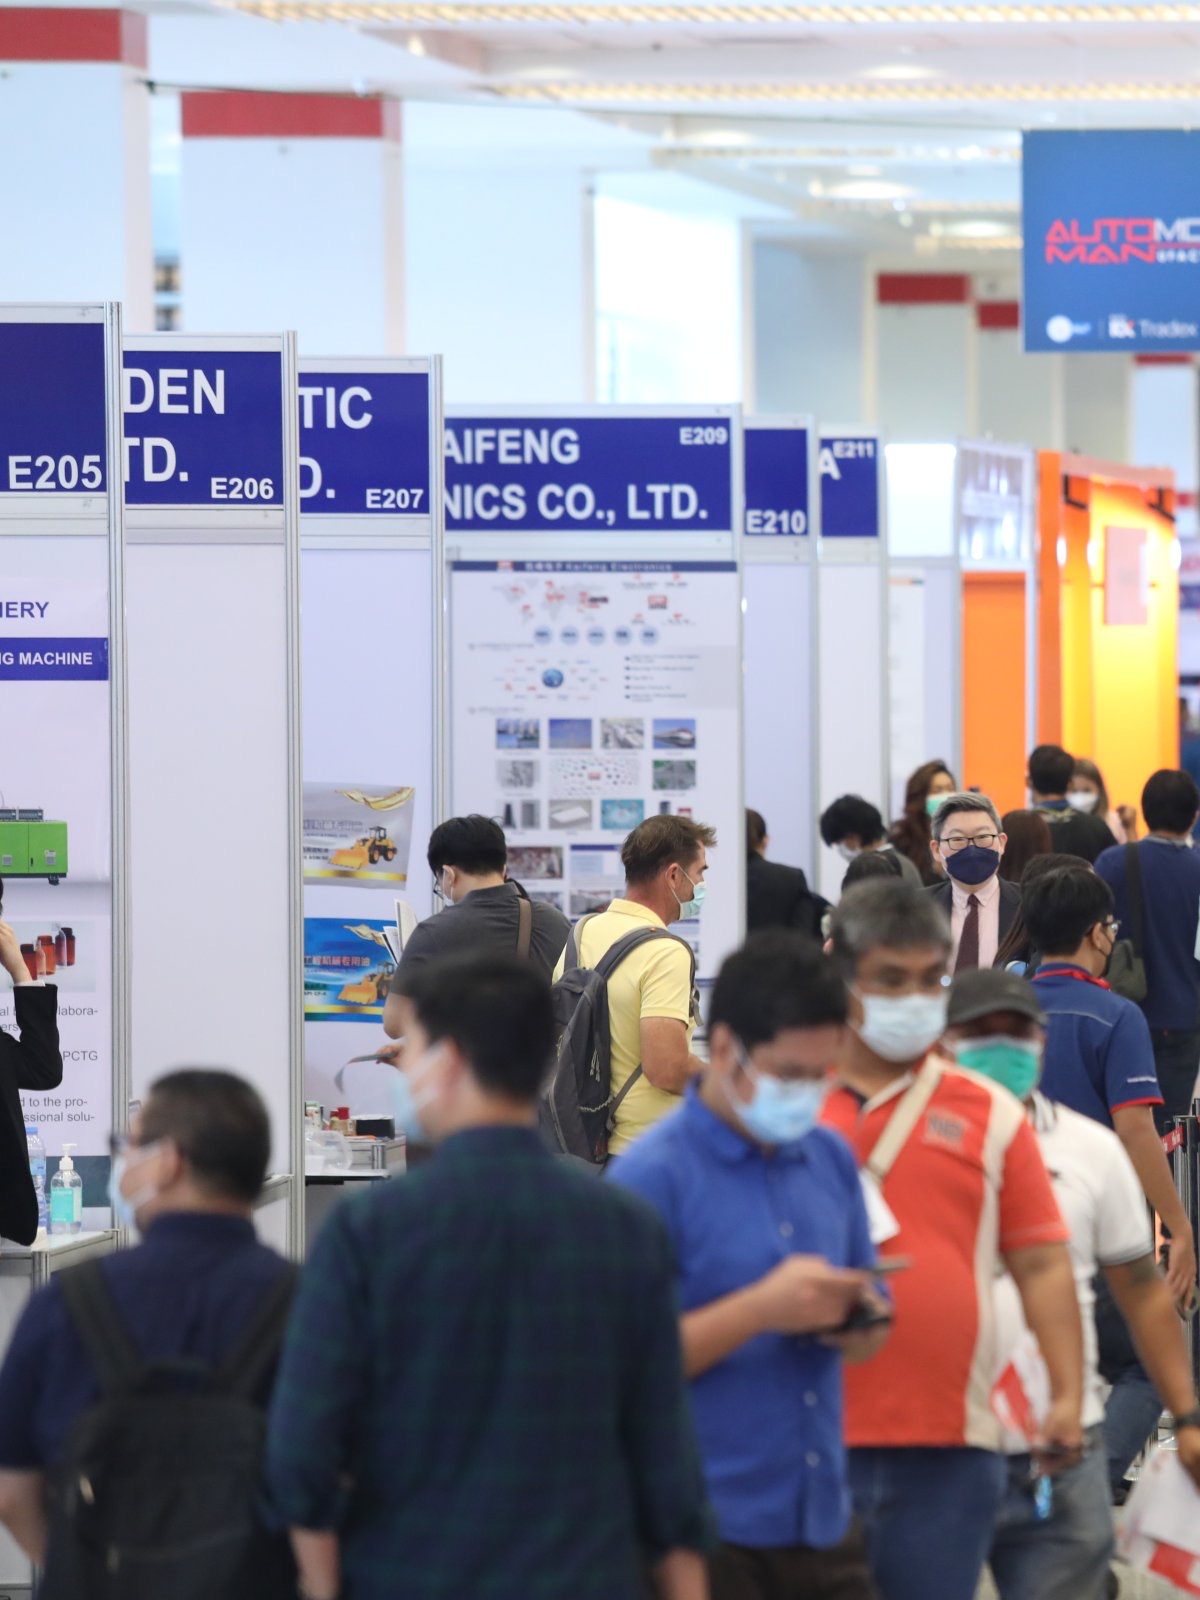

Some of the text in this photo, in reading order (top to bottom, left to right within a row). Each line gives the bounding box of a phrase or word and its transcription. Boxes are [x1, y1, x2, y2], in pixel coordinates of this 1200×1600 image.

[123, 368, 226, 415] DEN
[298, 386, 373, 430] TIC
[444, 428, 580, 465] AIFENG
[679, 427, 728, 446] E209
[833, 442, 875, 459] E211
[8, 455, 102, 490] E205
[819, 447, 841, 480] A
[210, 477, 274, 500] E206
[365, 488, 424, 509] E207
[537, 484, 616, 526] CO.,
[627, 484, 709, 520] LTD.
[746, 510, 807, 535] E210
[0, 602, 49, 618] ERY
[0, 652, 93, 666] G MACHINE
[63, 1051, 98, 1061] PCTG
[29, 1098, 40, 1107] to
[44, 1097, 61, 1107] the
[65, 1099, 88, 1110] pro-
[67, 1112, 95, 1122] solu-
